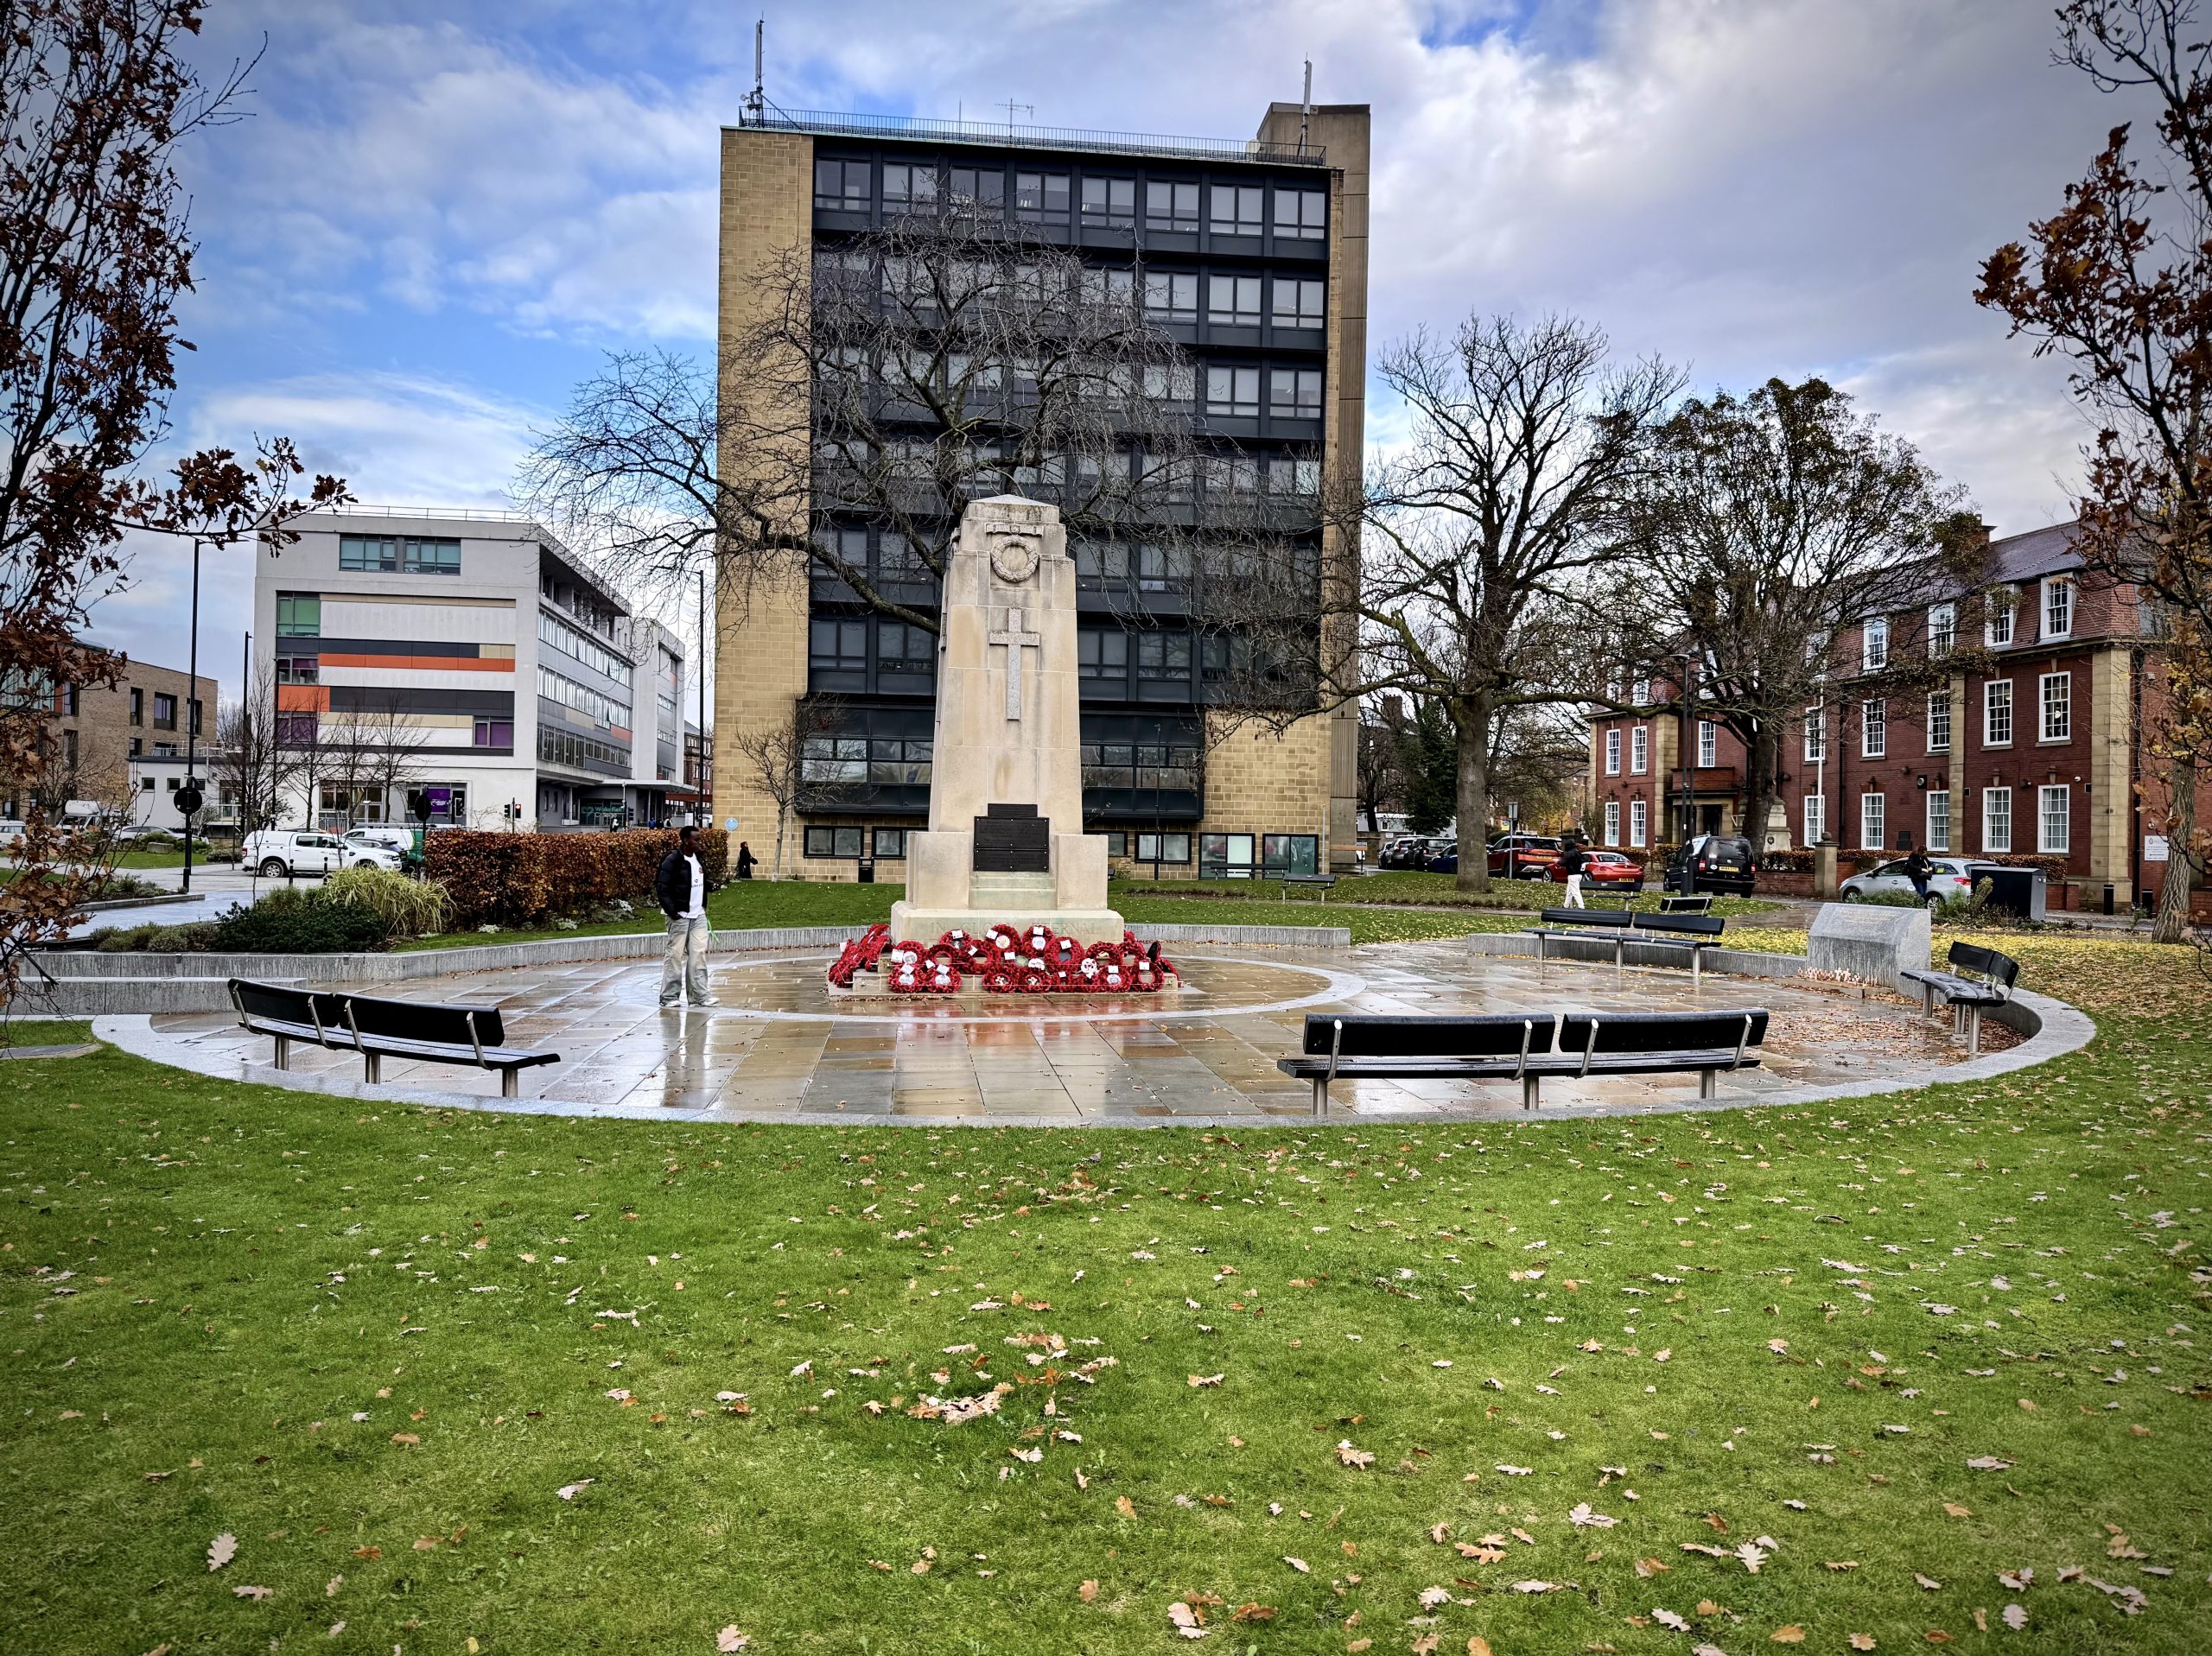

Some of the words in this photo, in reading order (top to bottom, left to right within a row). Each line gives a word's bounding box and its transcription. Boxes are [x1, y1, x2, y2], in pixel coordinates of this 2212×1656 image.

[931, 922, 947, 934] IN
[961, 922, 1017, 935] GLO
[1031, 922, 1099, 935] ERNAL
